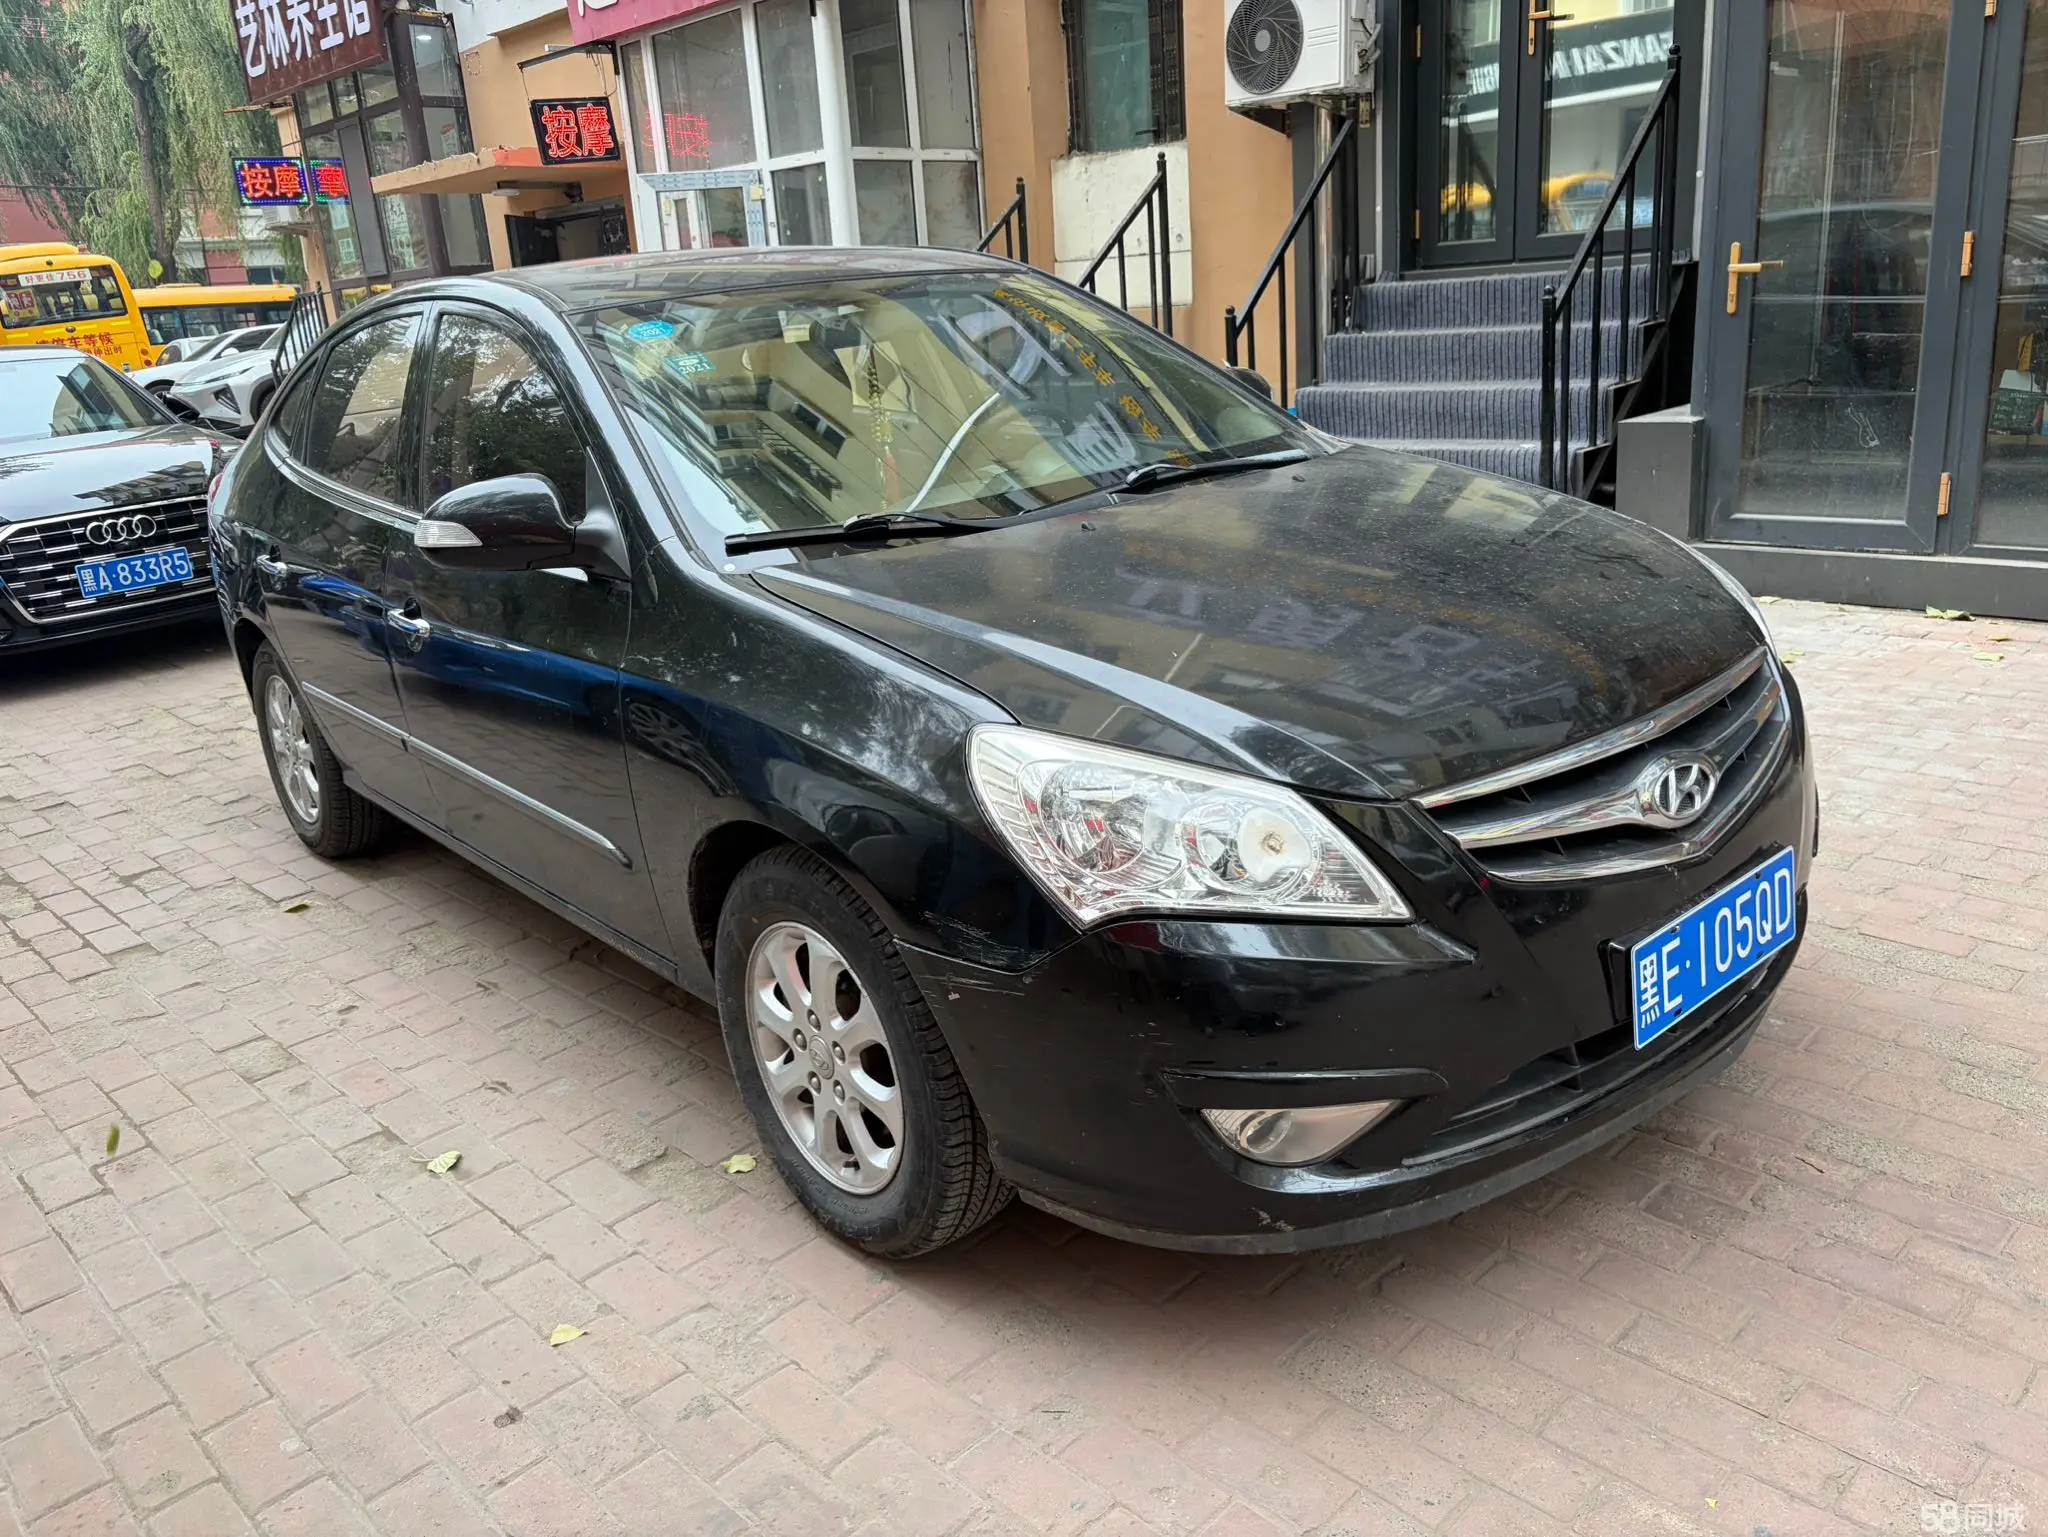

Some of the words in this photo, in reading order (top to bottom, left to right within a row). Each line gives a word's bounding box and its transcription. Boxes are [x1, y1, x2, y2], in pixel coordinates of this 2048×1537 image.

[542, 103, 615, 157] 按摩
[240, 163, 302, 198] 按摩
[679, 362, 710, 374] 2021
